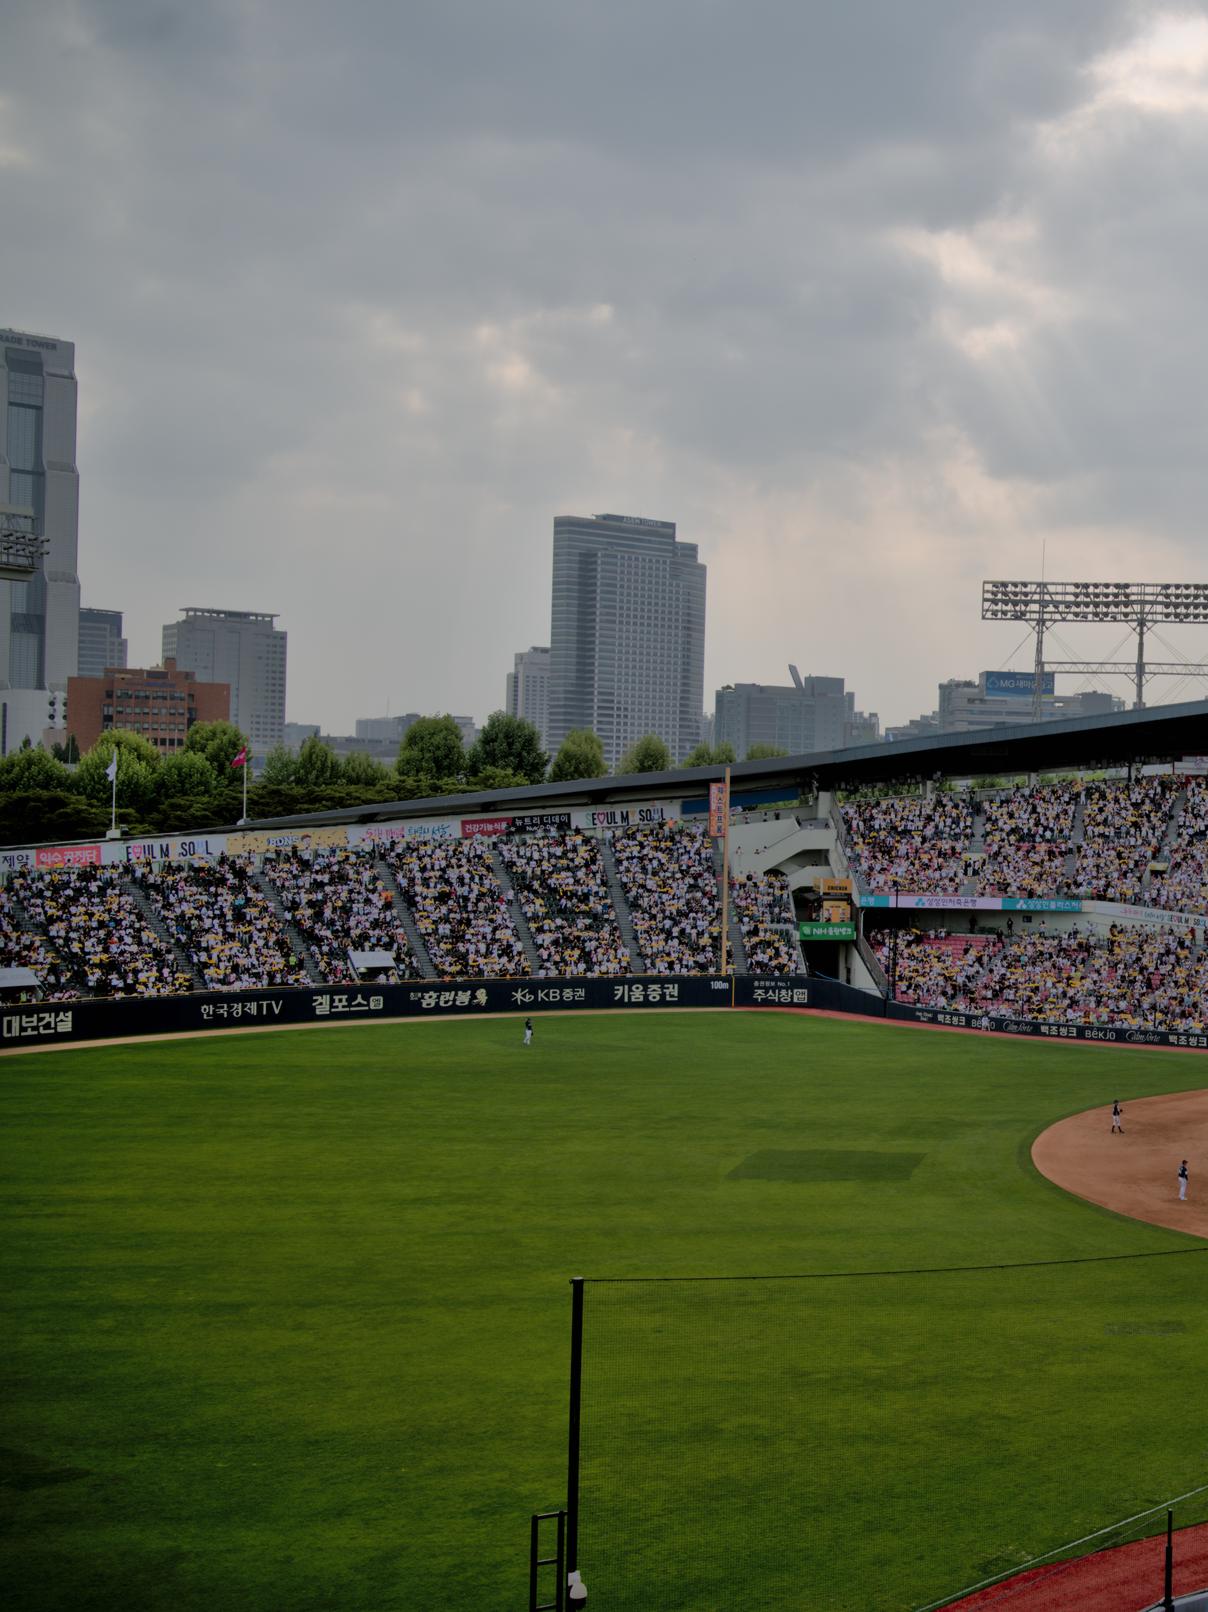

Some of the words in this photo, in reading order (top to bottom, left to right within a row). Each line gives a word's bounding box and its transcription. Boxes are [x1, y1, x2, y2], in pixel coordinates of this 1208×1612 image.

[1, 854, 30, 868] 제약
[927, 898, 977, 907] 상상인저축은행
[710, 980, 729, 989] 100m
[538, 987, 586, 1002] KB증권
[613, 984, 679, 1003] 키움증권
[201, 1000, 284, 1019] 한국경제TV
[2, 1010, 73, 1038] 대보건설
[937, 1013, 966, 1026] 백조씽크
[1040, 1024, 1077, 1037] 백조씽크
[1168, 1034, 1207, 1047] 백조씽크
